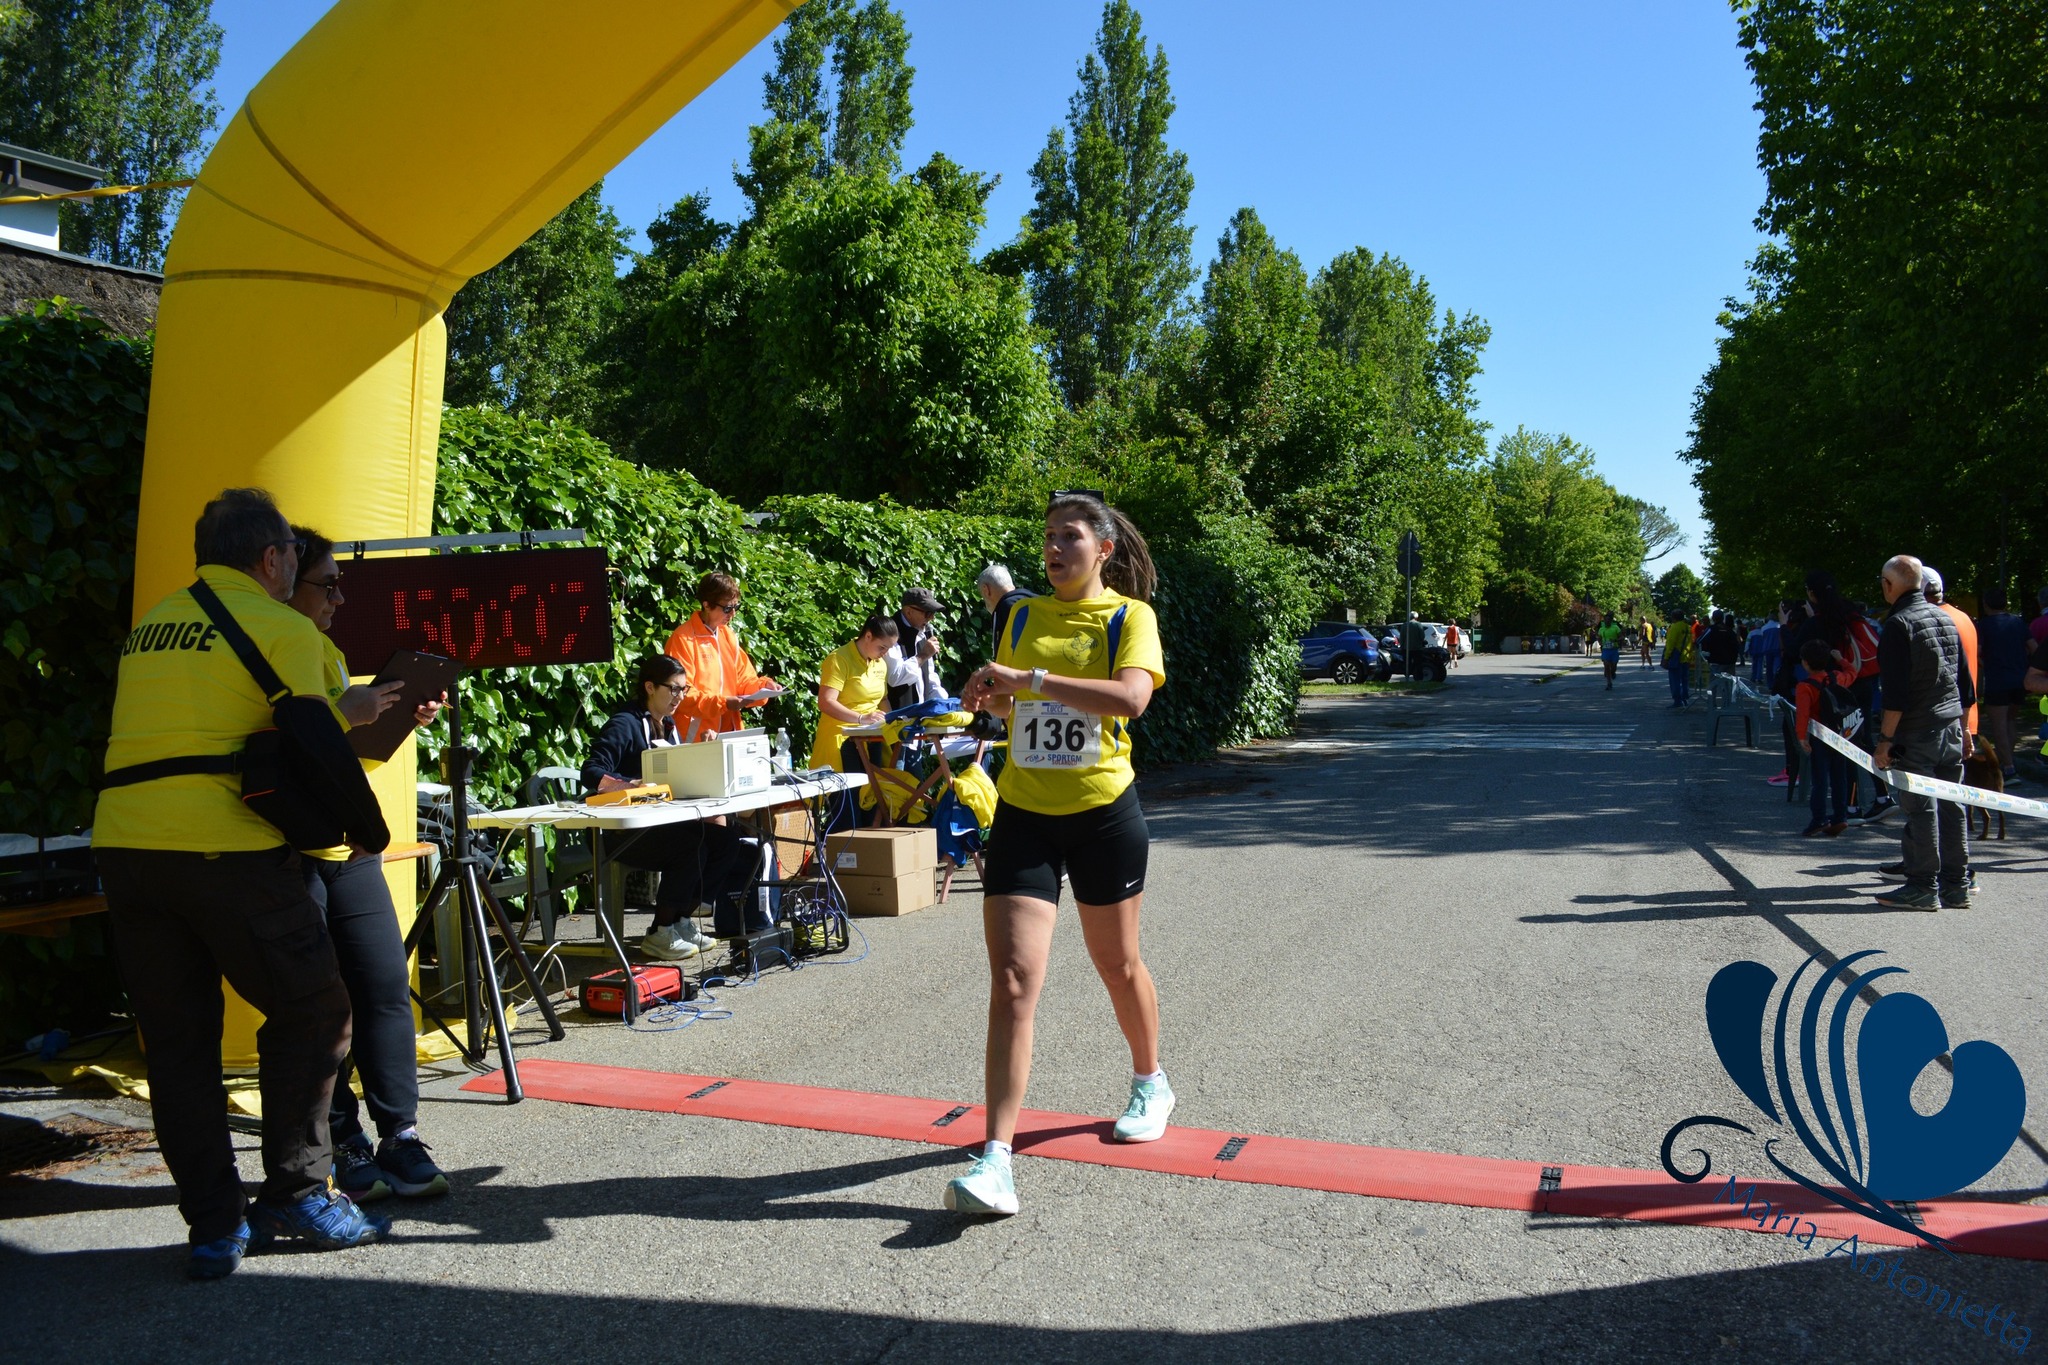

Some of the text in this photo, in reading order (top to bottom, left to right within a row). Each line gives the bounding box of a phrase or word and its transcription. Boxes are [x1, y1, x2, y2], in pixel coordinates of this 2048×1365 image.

[122, 621, 218, 656] GIUDICE
[1842, 708, 1862, 728] NIKE
[1025, 717, 1085, 752] 136
[1047, 753, 1082, 762] SPORTGM
